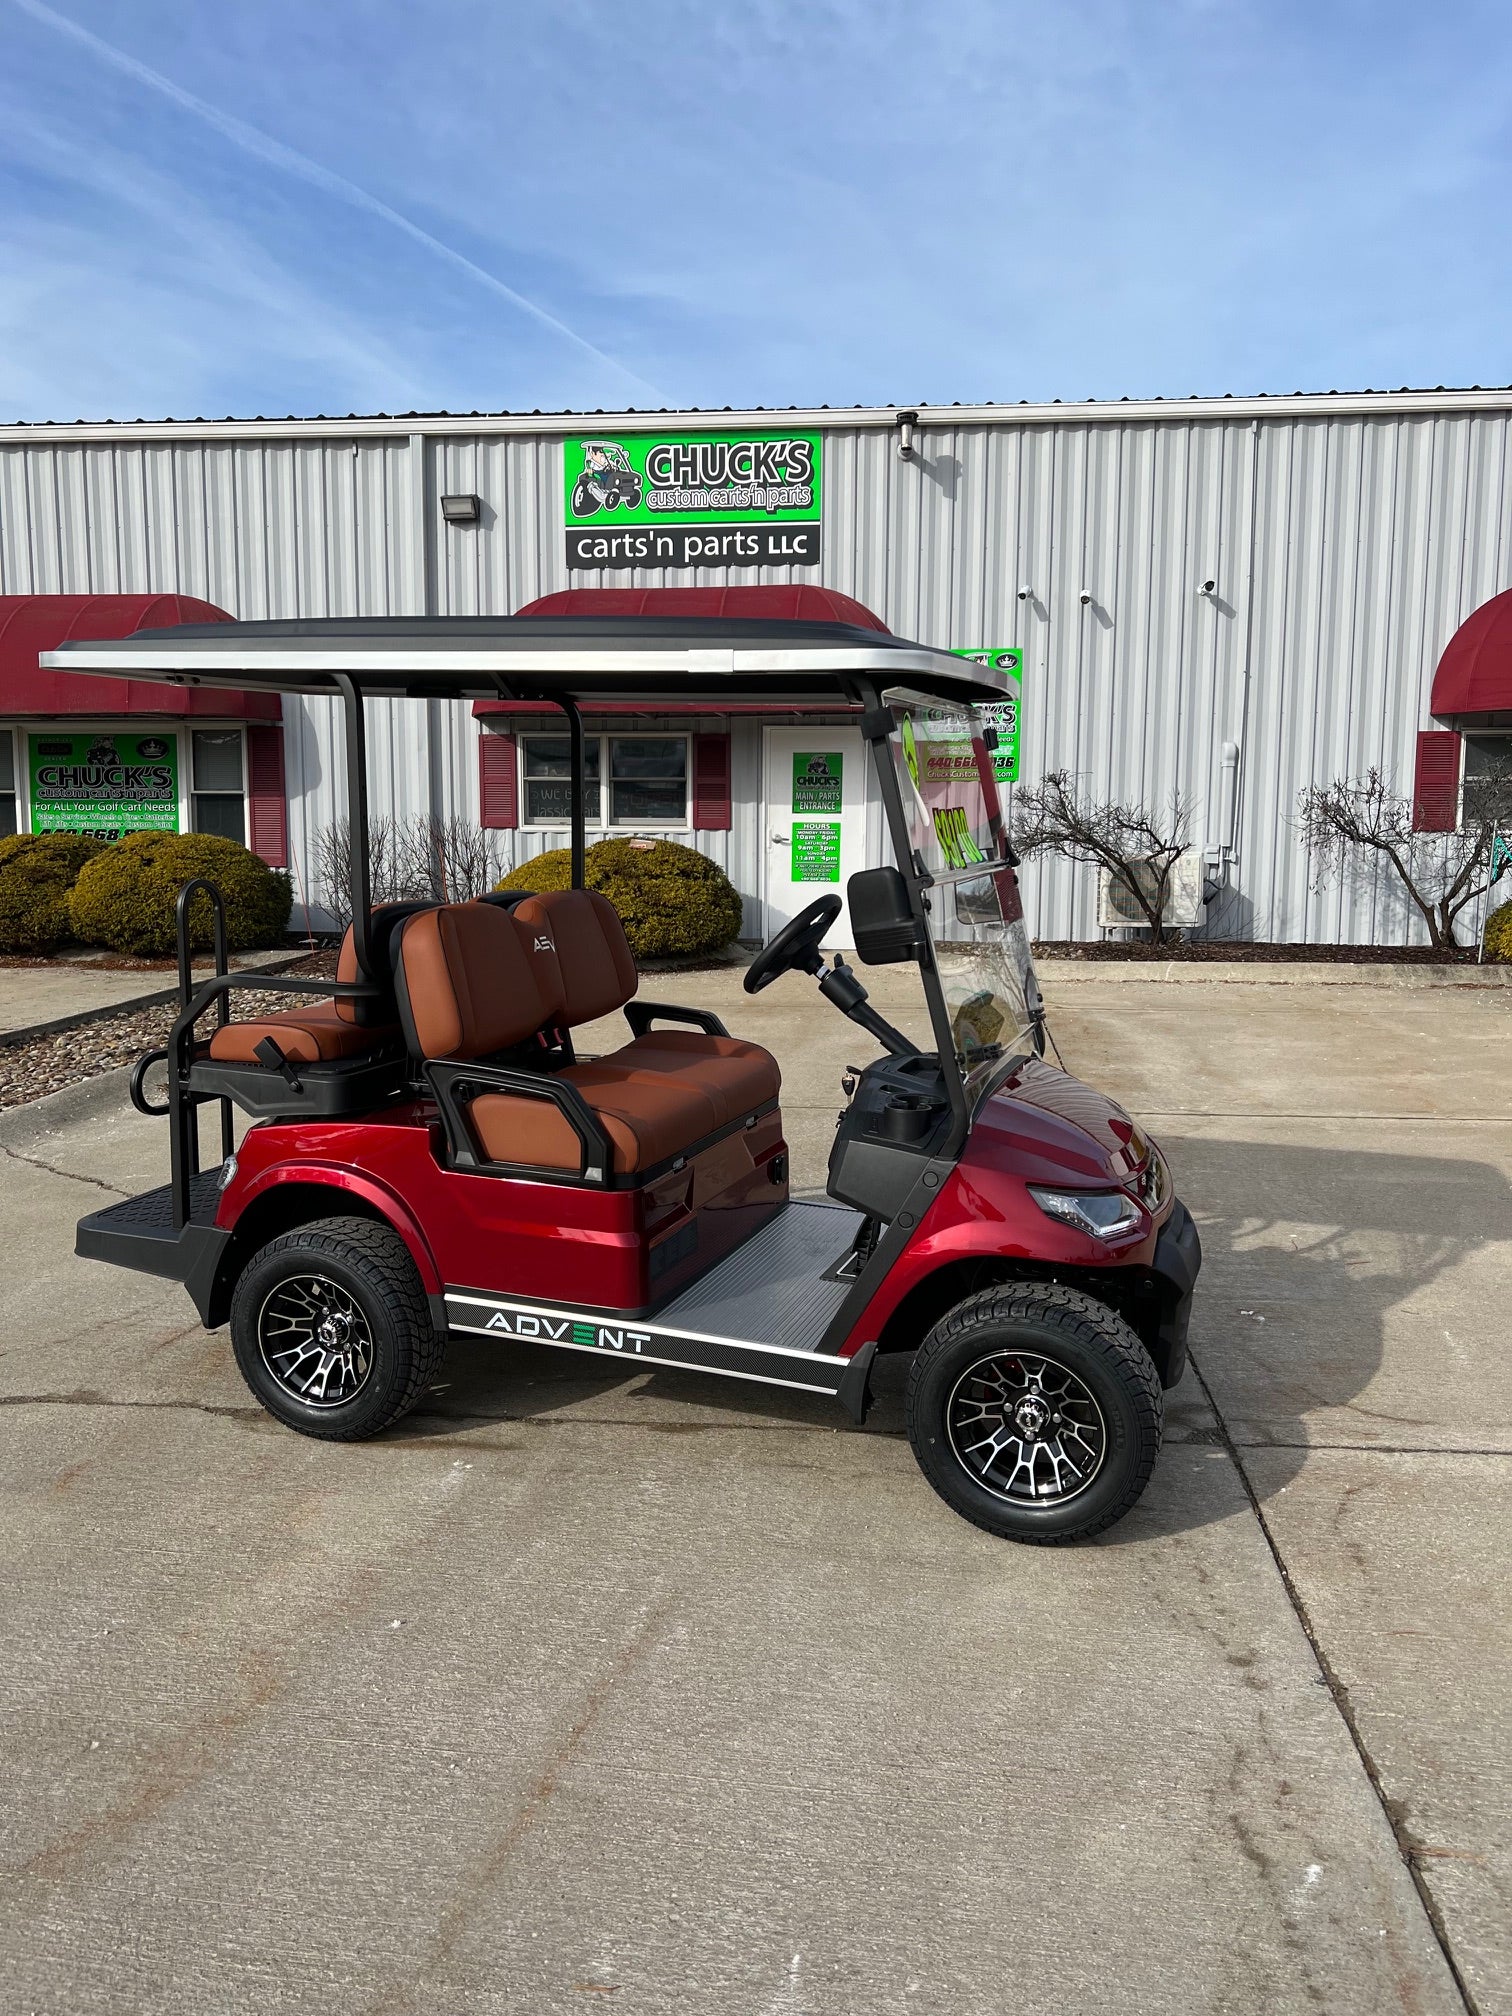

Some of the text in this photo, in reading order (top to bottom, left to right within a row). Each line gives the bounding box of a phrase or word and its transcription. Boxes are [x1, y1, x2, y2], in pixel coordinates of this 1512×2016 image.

[646, 441, 812, 487] CHUCK'S
[646, 489, 708, 508] custom
[766, 485, 811, 510] parts
[684, 531, 759, 563] parts
[768, 535, 808, 554] LLC
[37, 765, 173, 789] CHUCK'S
[37, 787, 87, 799] custom
[135, 787, 173, 801] parts
[564, 789, 591, 800] BY
[796, 792, 815, 801] MAIN
[819, 792, 840, 801] PARTS
[35, 801, 176, 812] For ALL Your Golf Cart Needs
[537, 802, 571, 817] lassic
[799, 802, 836, 811] ENTRANCE
[485, 1312, 651, 1353] ADVENT
